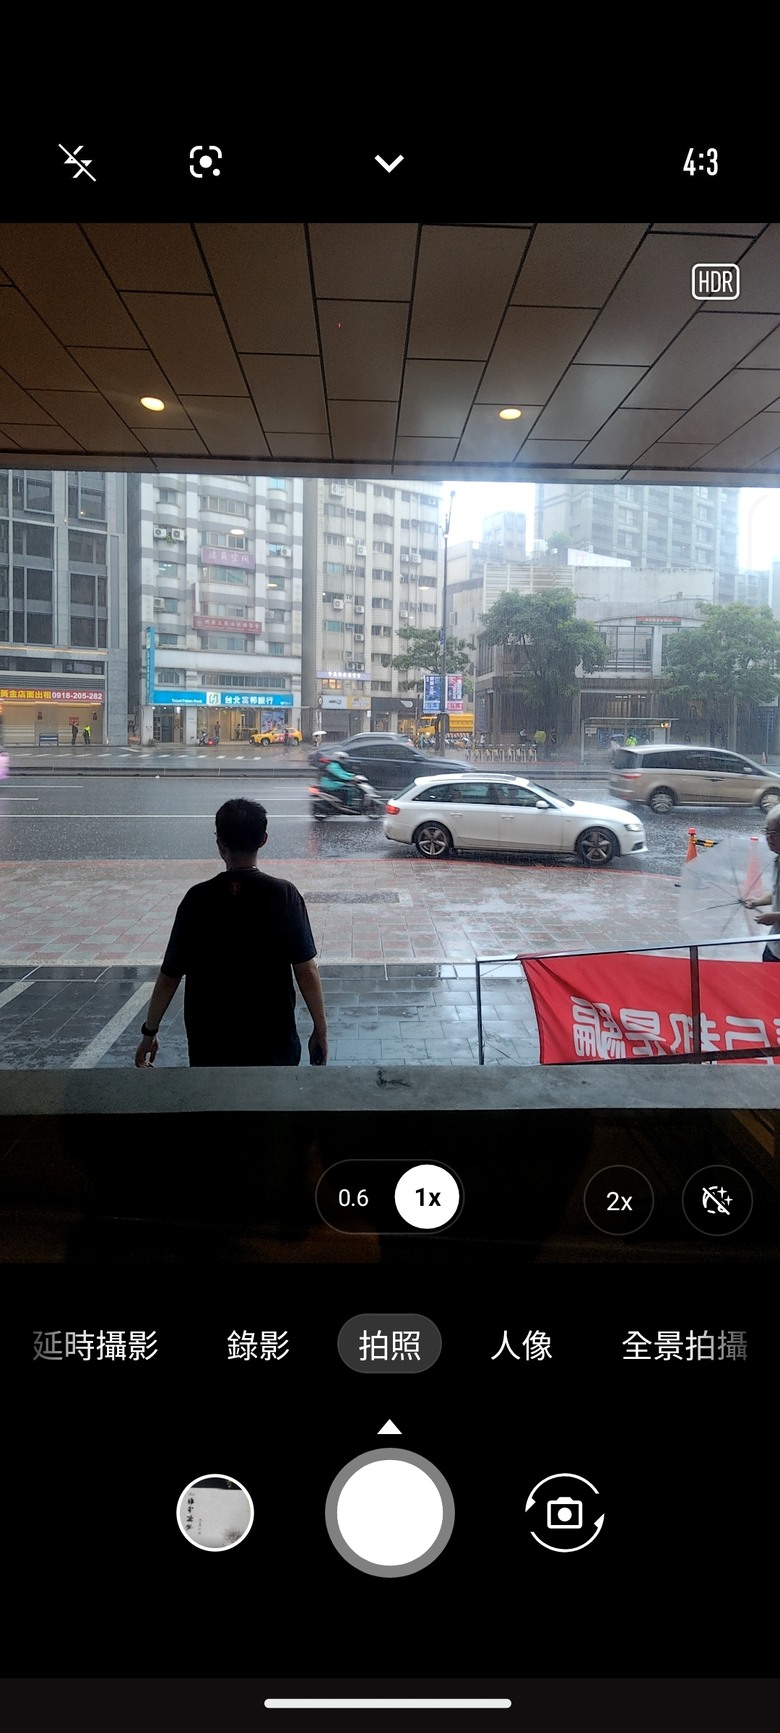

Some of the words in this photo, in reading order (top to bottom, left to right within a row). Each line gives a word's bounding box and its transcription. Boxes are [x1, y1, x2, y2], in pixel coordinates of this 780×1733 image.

[52, 691, 103, 700] 0918-205-282
[224, 695, 274, 705] 台北富邦銀行
